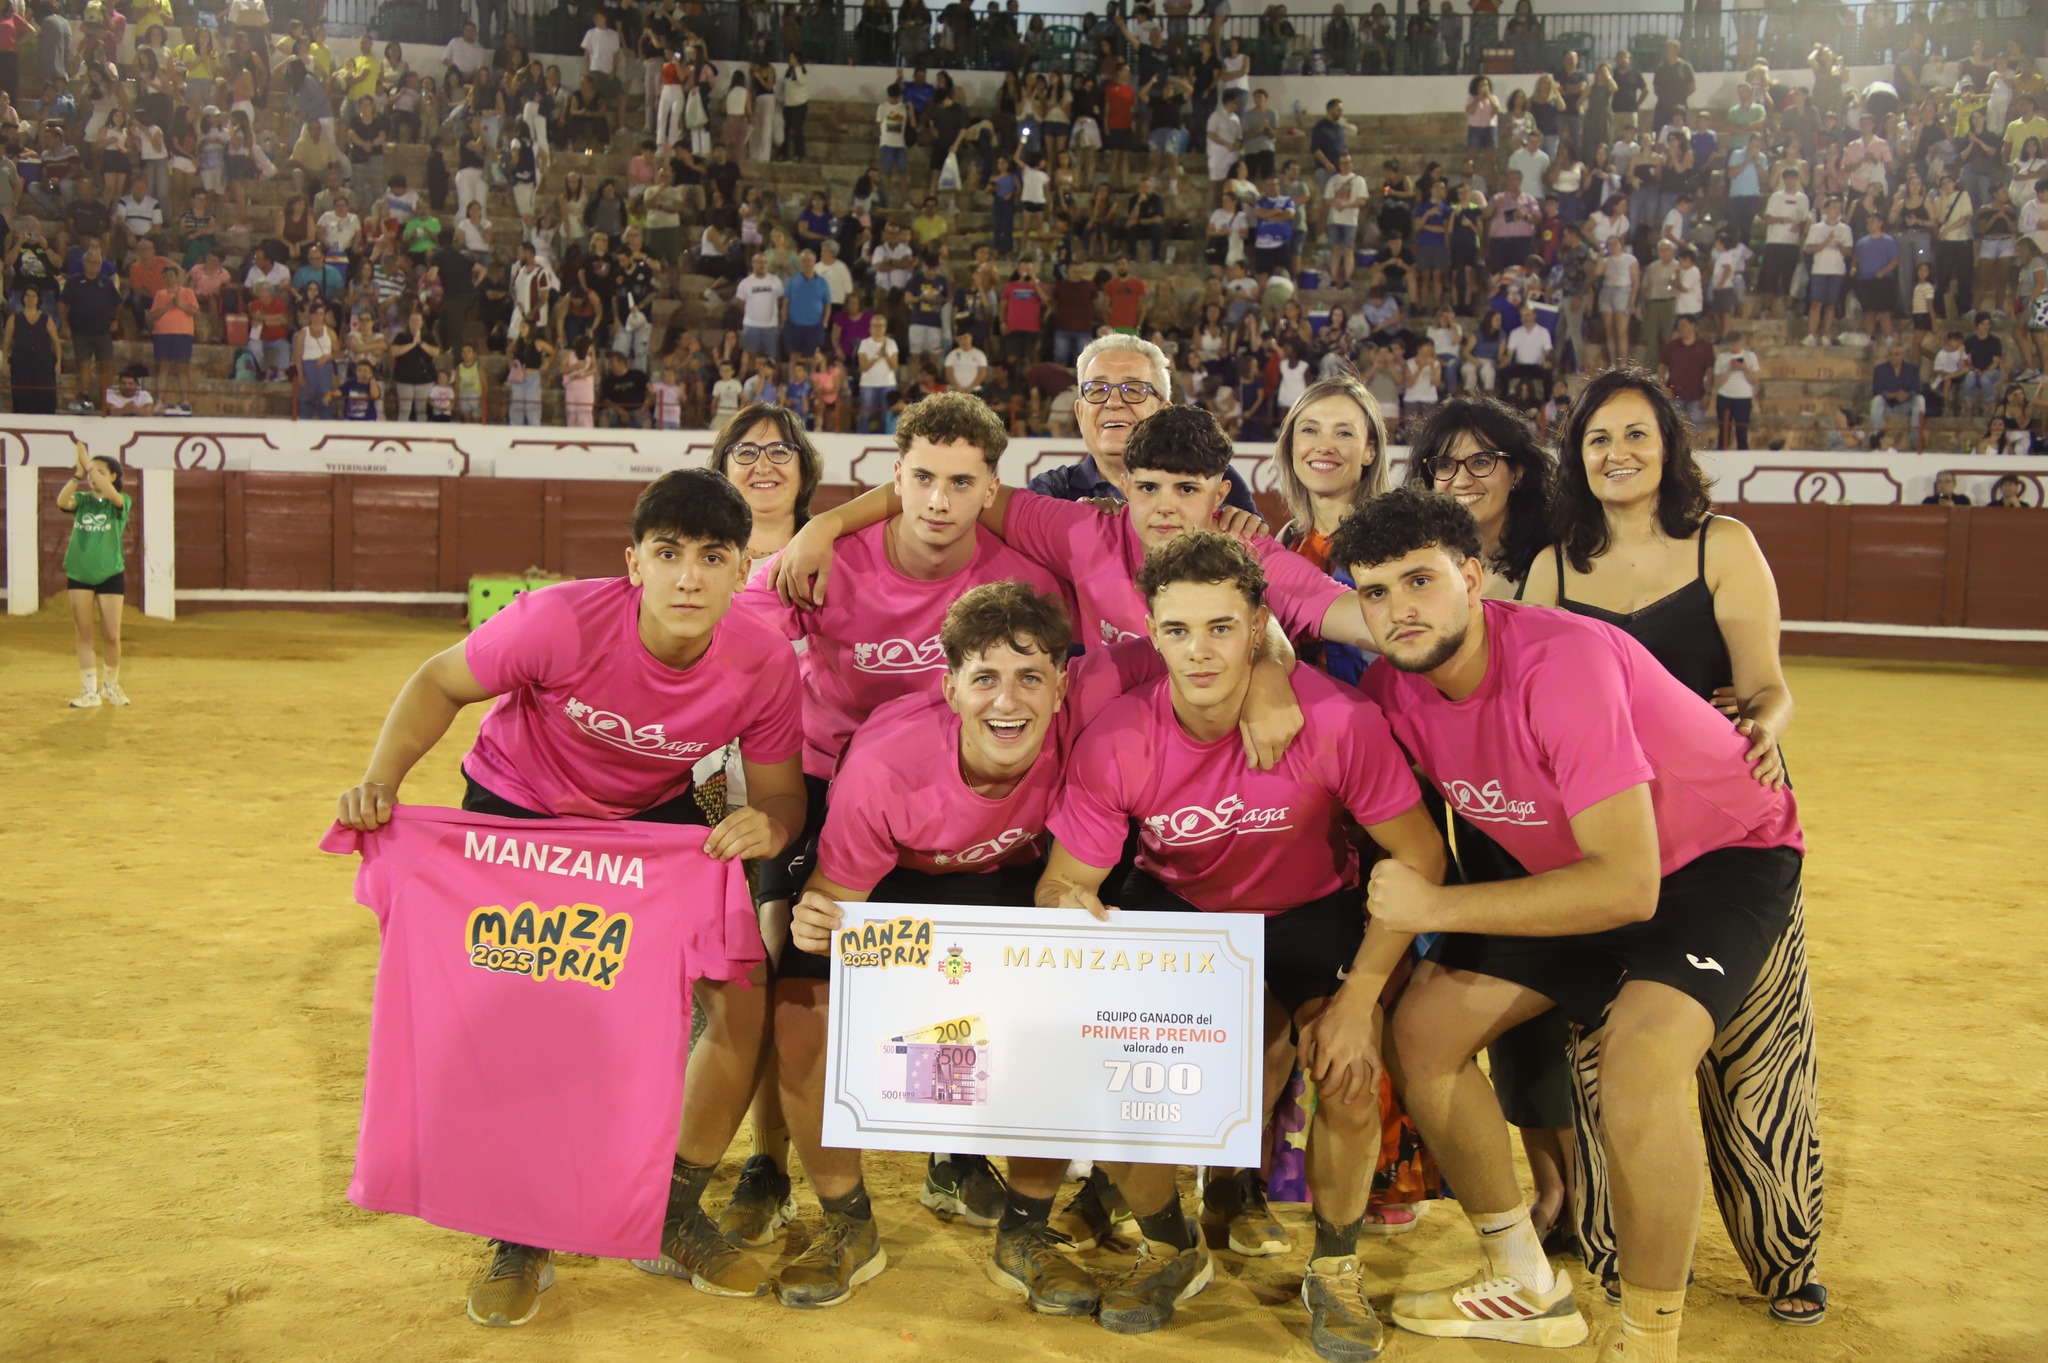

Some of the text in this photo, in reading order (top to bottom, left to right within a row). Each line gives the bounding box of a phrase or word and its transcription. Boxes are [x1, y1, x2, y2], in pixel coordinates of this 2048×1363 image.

[191, 442, 207, 470] 2
[326, 463, 388, 473] VETERINARIOS
[1810, 476, 1827, 503] 2
[463, 831, 645, 889] MANZANA
[471, 907, 627, 955] MANZA
[840, 919, 931, 956] MANZA
[471, 944, 619, 986] 2025 PRIX
[843, 945, 930, 967] 2025 PRIX
[1002, 945, 1216, 974] MANZAPRIX
[1096, 1010, 1213, 1026] EQUIPO GANADOR del
[934, 1020, 971, 1043] 200
[1081, 1024, 1227, 1044] PRIMER PREMIO
[883, 1045, 895, 1054] 500
[940, 1047, 977, 1066] 500
[1123, 1041, 1184, 1054] valorado en
[1102, 1060, 1203, 1096] 700
[881, 1090, 898, 1100] 500
[1120, 1100, 1182, 1123] EUROS
